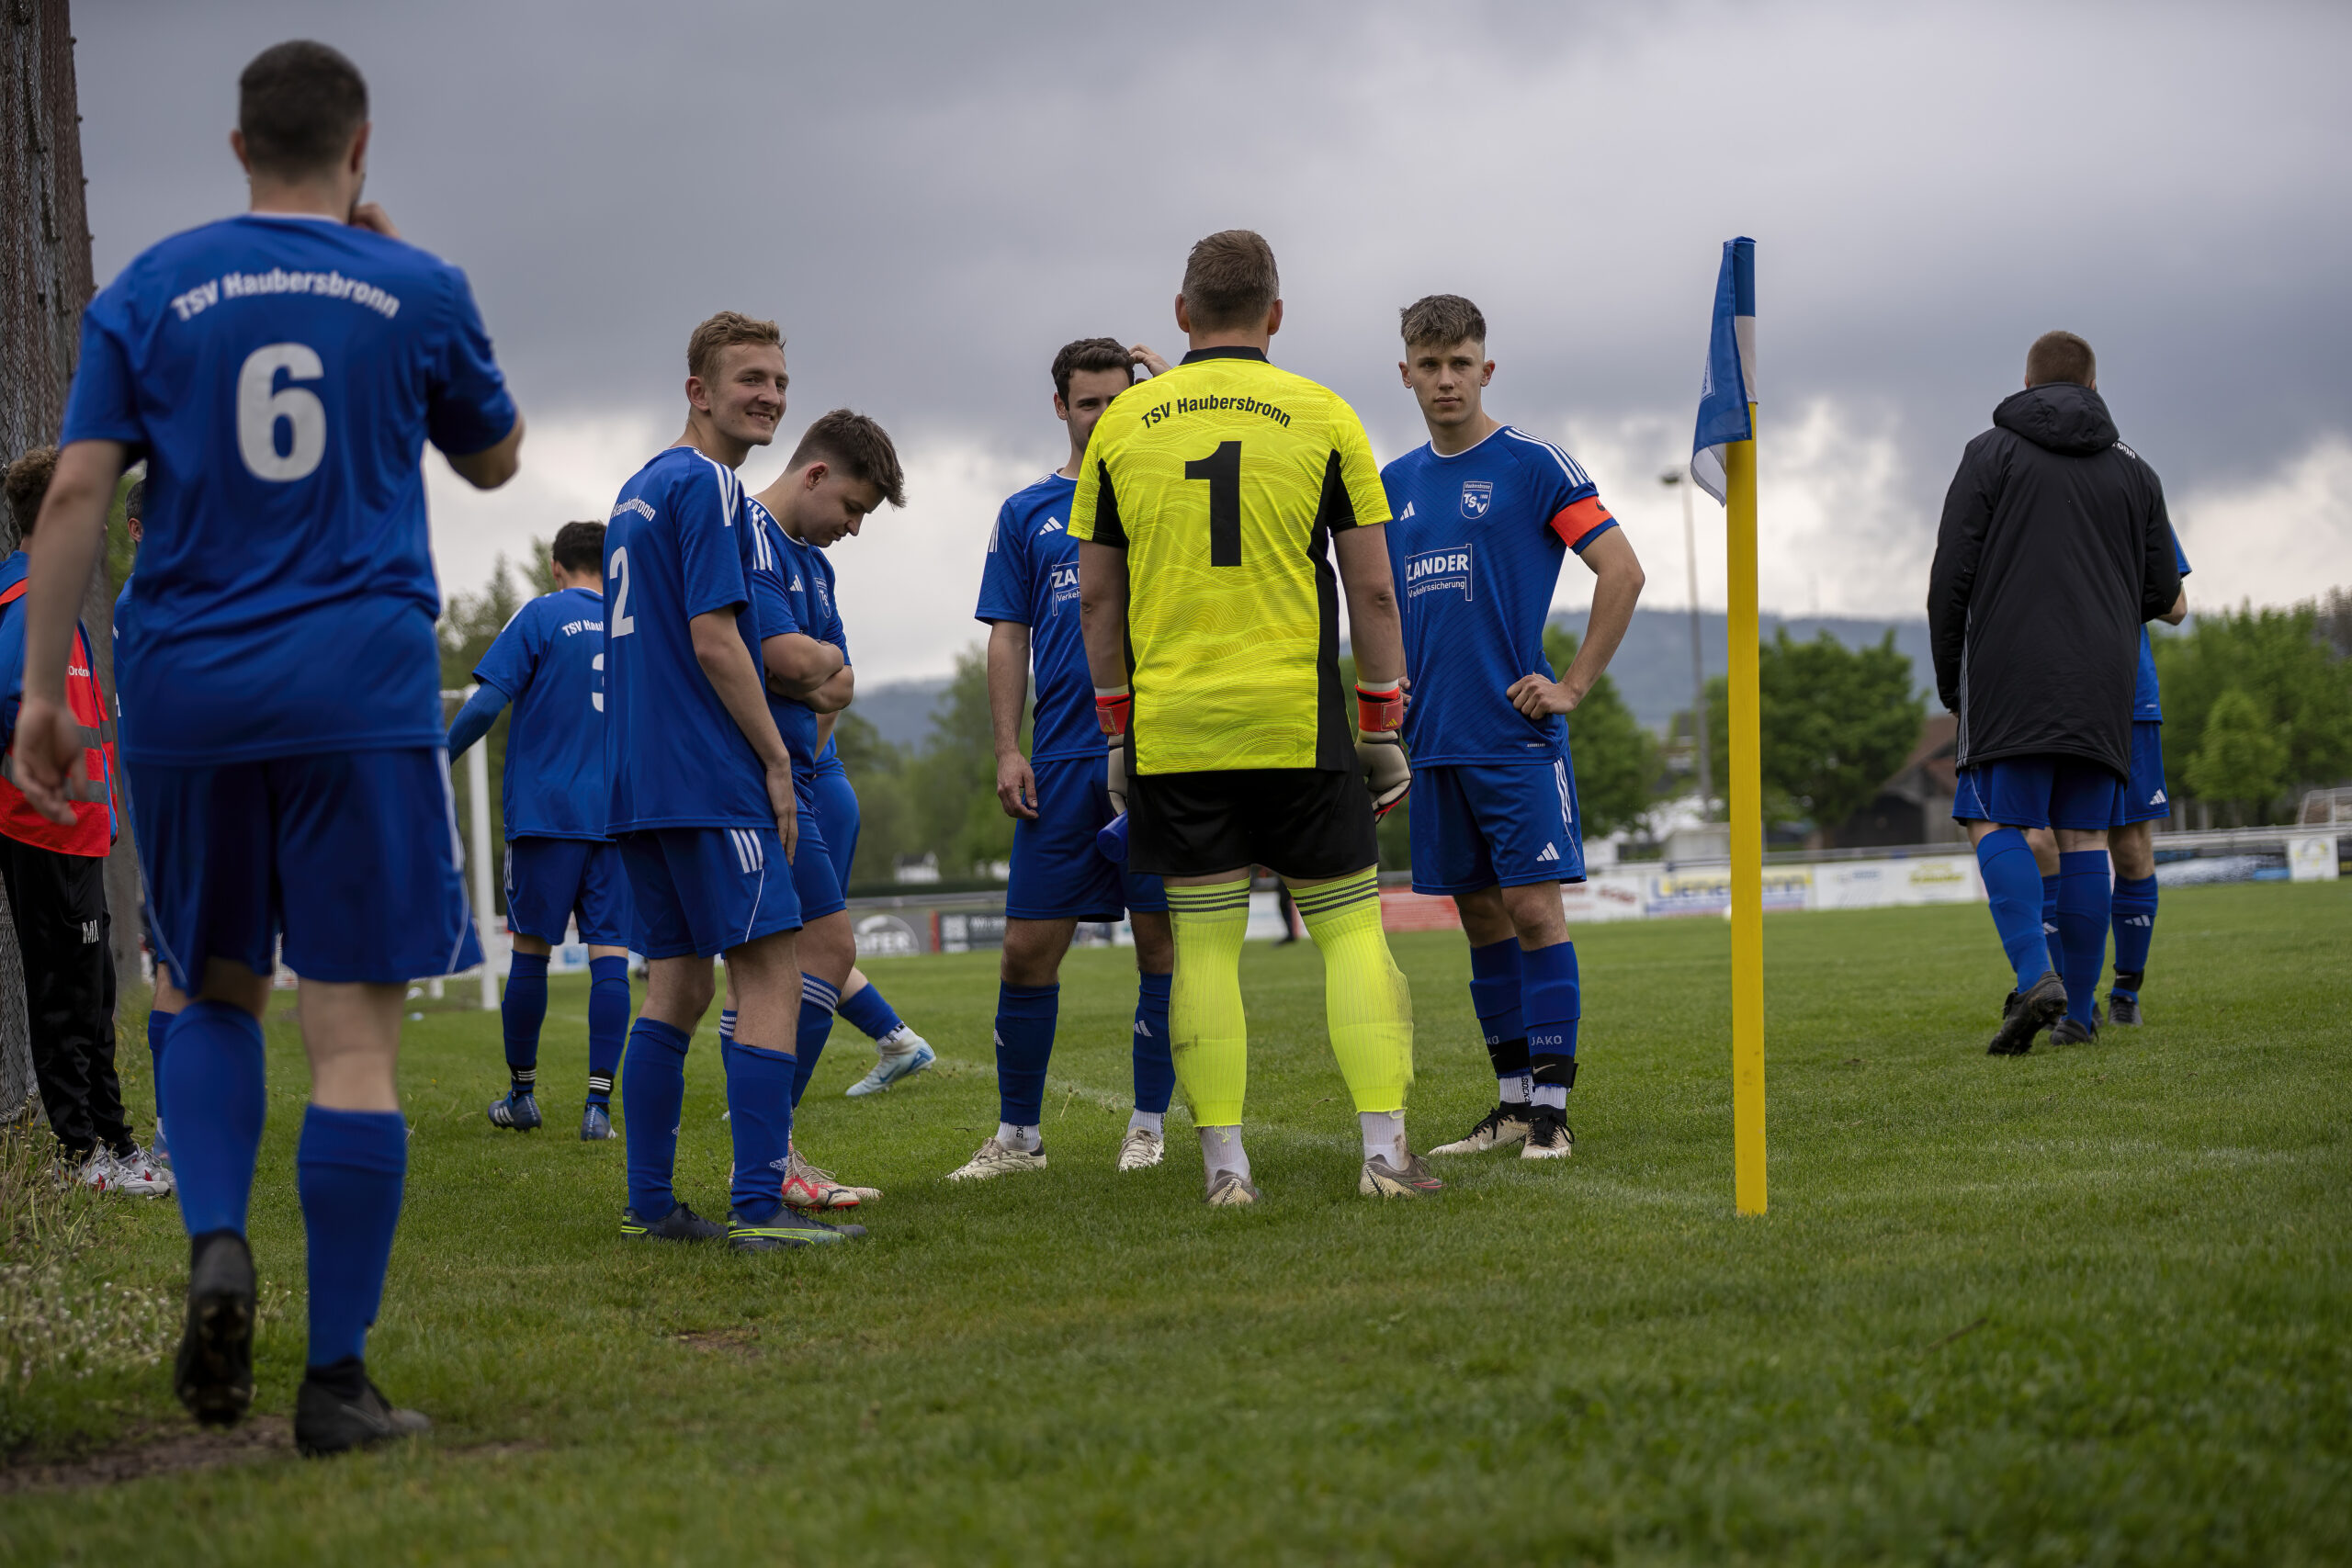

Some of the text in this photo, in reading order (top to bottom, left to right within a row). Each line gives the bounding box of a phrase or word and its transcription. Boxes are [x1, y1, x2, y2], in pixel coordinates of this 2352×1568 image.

[169, 266, 401, 321] TSV Haubersbronn
[234, 342, 327, 483] 6
[1141, 394, 1292, 429] TSV Haubersbronn
[1184, 440, 1243, 568] 1
[609, 546, 635, 639] 2
[561, 619, 582, 637] TSV
[1531, 1035, 1563, 1046] JAKO
